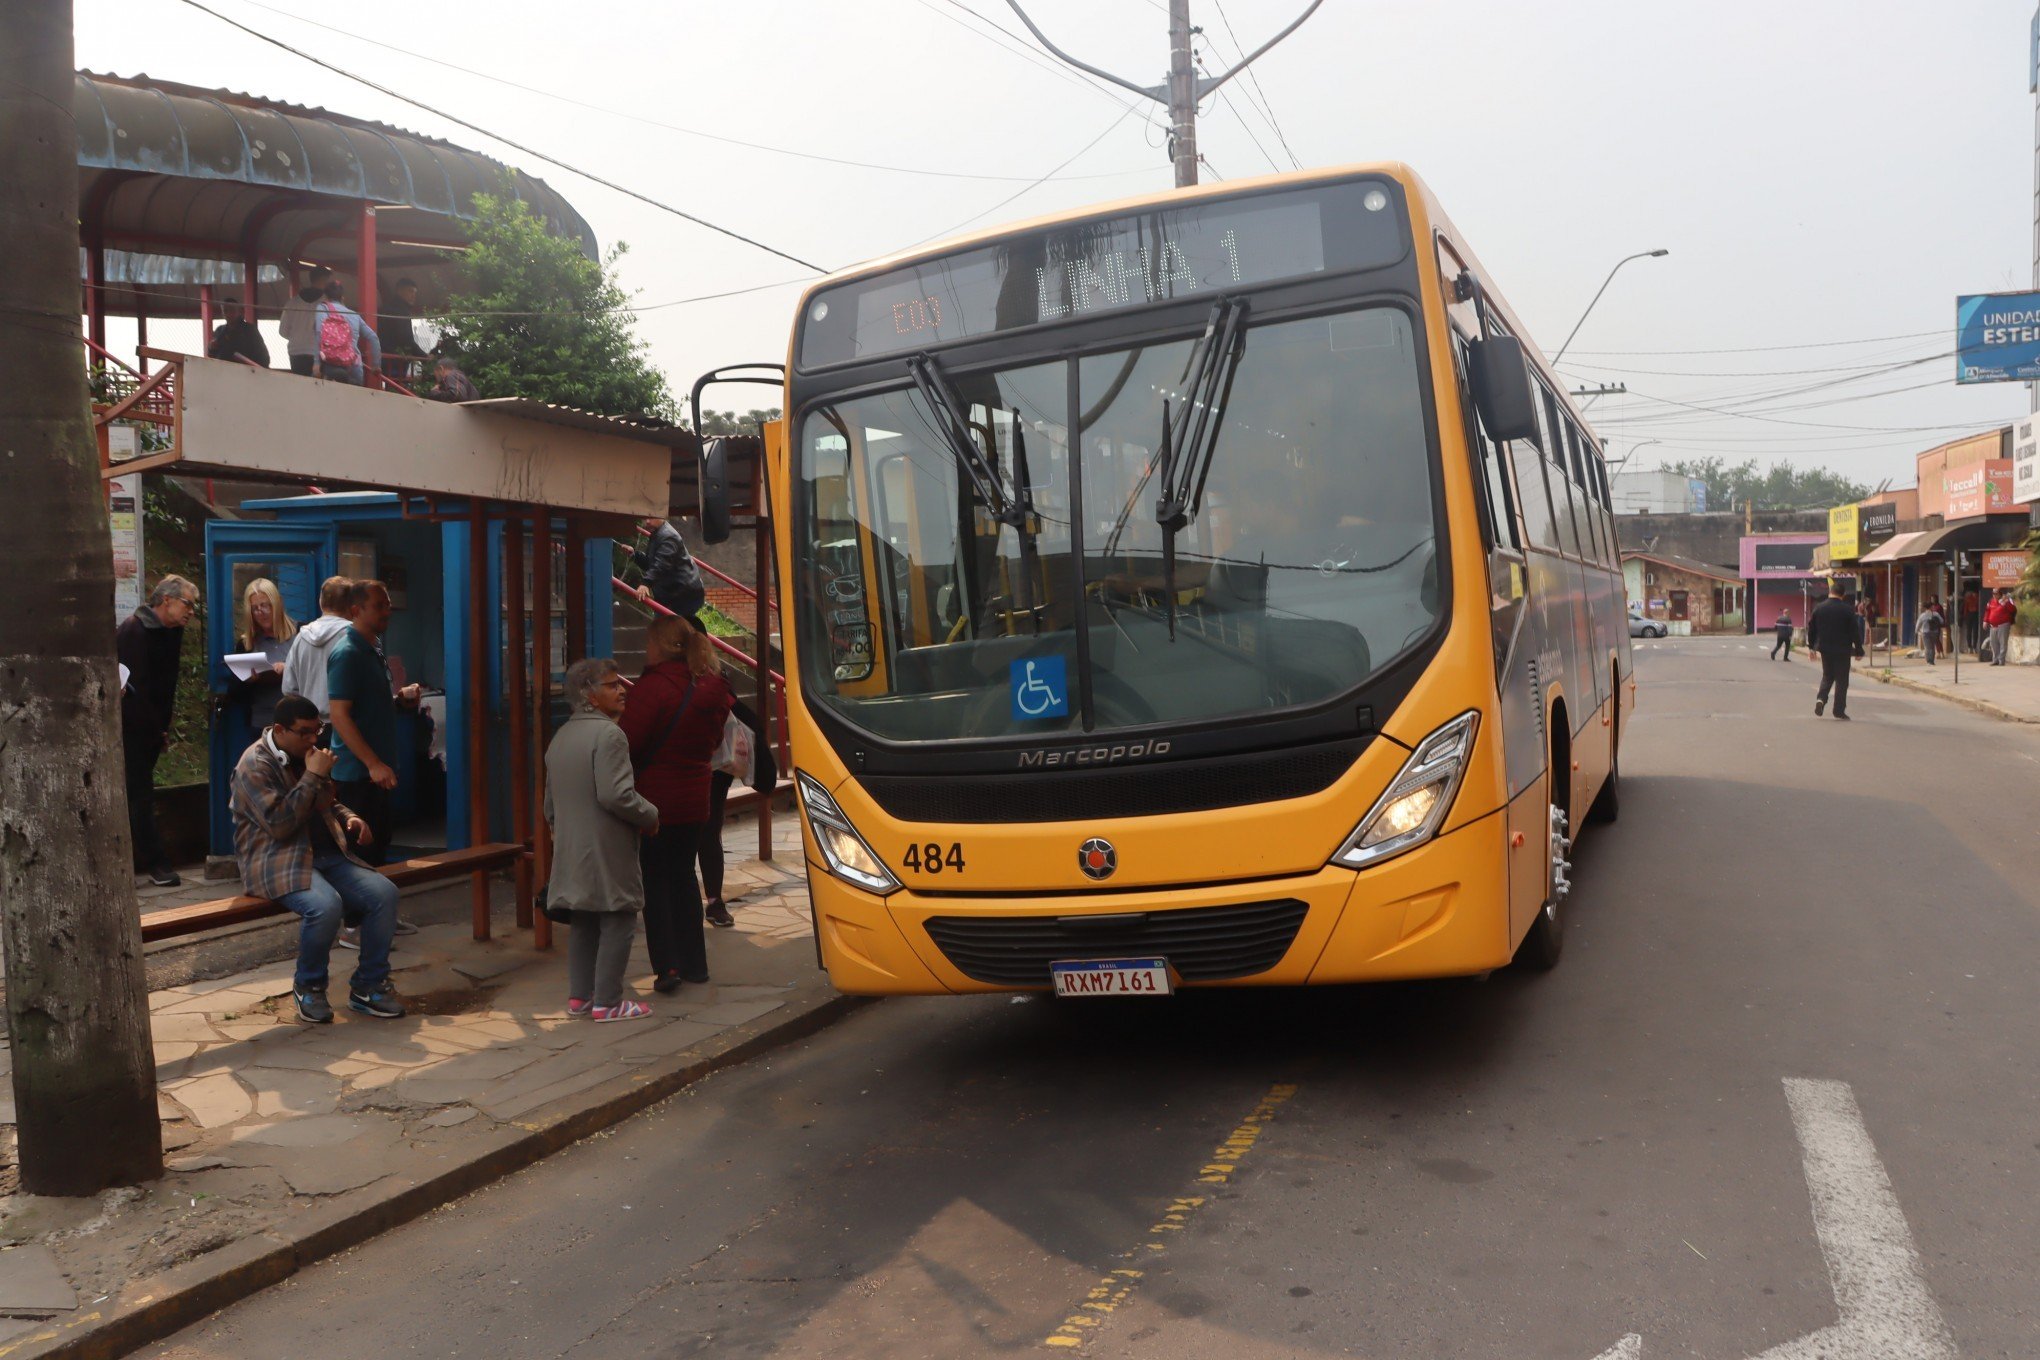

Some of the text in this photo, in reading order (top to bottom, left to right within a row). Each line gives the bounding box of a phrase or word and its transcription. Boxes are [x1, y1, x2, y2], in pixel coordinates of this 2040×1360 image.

[1036, 229, 1241, 317] LINHA 1
[1834, 509, 1852, 525] DENTISTA
[1869, 514, 1895, 527] ERONILDA
[1018, 739, 1171, 767] Marcopolo
[903, 842, 966, 874] 484
[1063, 971, 1156, 993] RXM7I61
